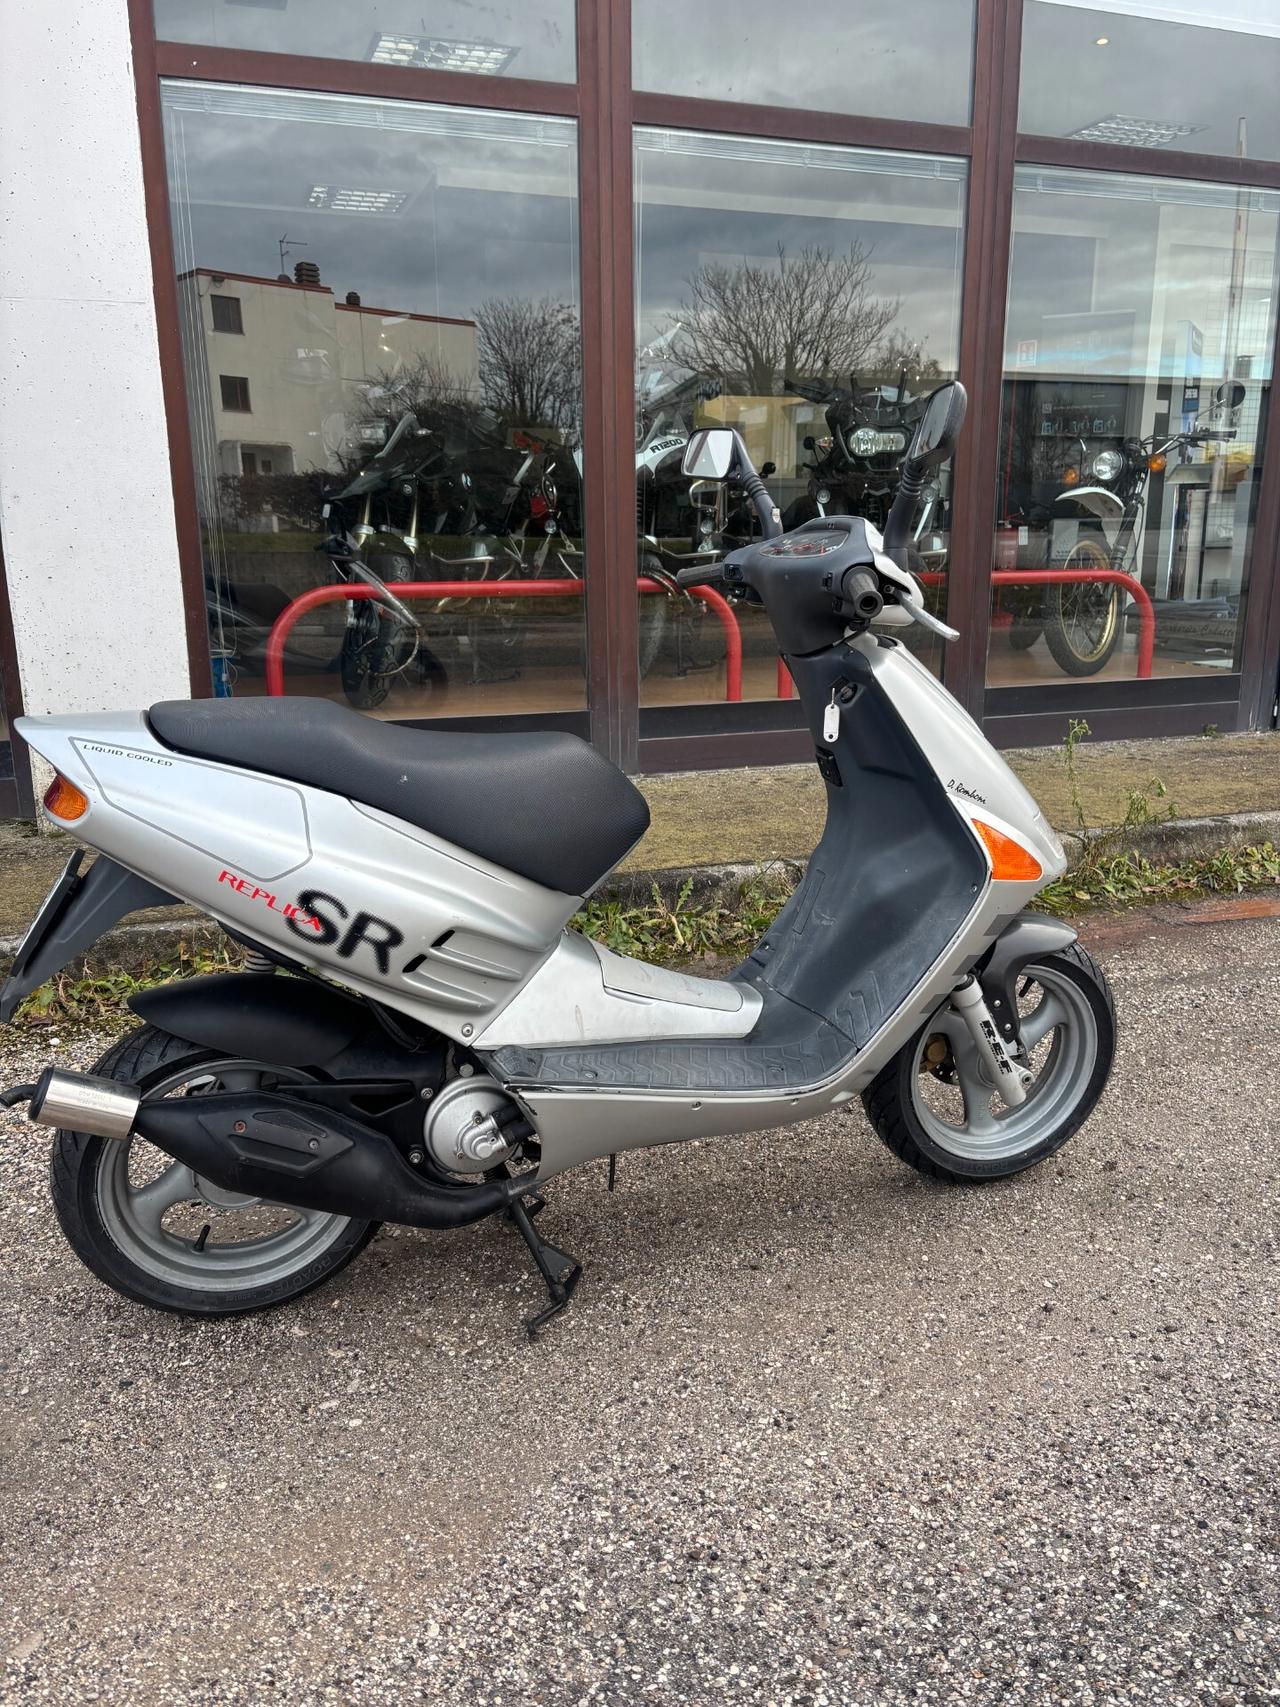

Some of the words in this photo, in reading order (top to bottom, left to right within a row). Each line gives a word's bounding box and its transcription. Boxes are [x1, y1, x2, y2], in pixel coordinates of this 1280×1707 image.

[649, 438, 684, 454] R1200
[84, 744, 123, 756] LIQUID
[126, 752, 173, 767] COOLED
[219, 871, 320, 932] REPLICA
[284, 889, 405, 976] SR
